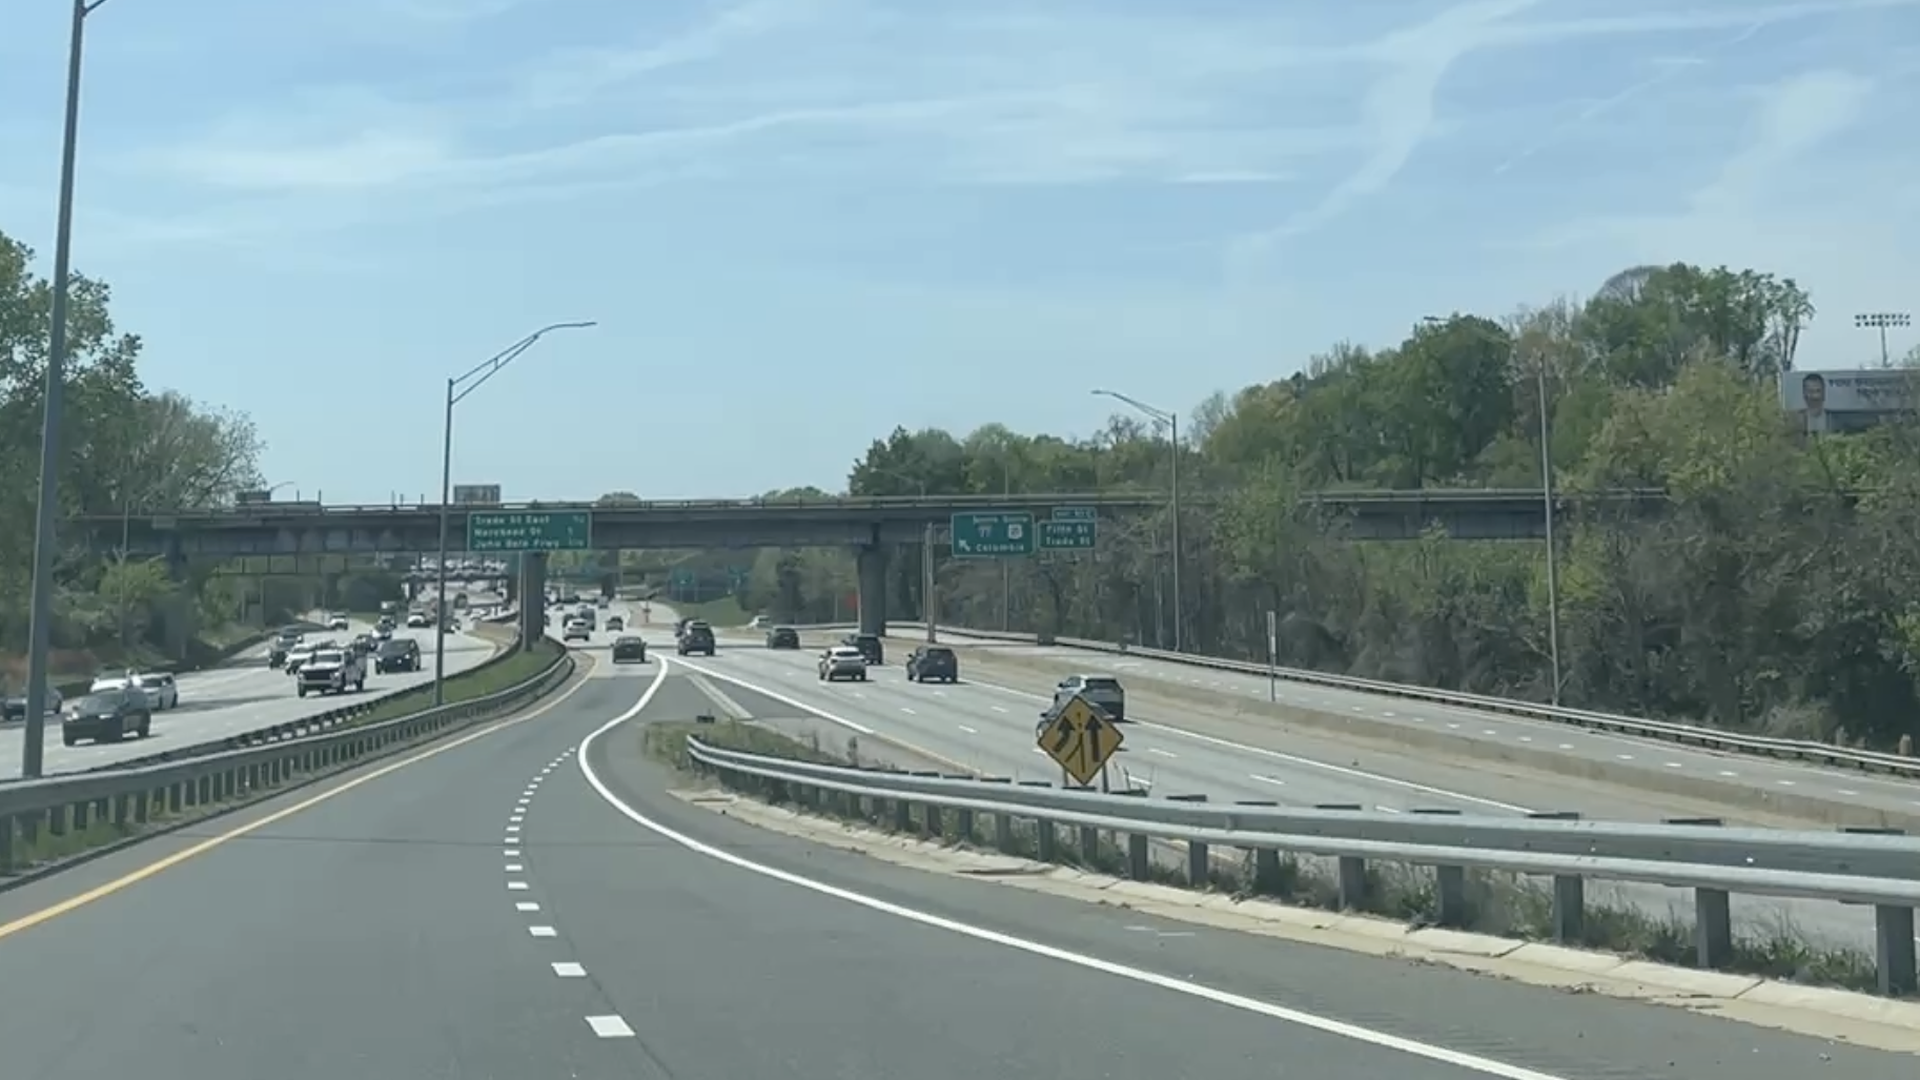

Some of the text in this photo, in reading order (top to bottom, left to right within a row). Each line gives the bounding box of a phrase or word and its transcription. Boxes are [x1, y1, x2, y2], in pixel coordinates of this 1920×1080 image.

[475, 515, 505, 524] Trade
[510, 515, 522, 524] St
[526, 515, 550, 524] East
[529, 526, 542, 536] St
[1077, 523, 1088, 533] St
[1046, 536, 1090, 545] Trade St
[976, 544, 1024, 552] Columbia
